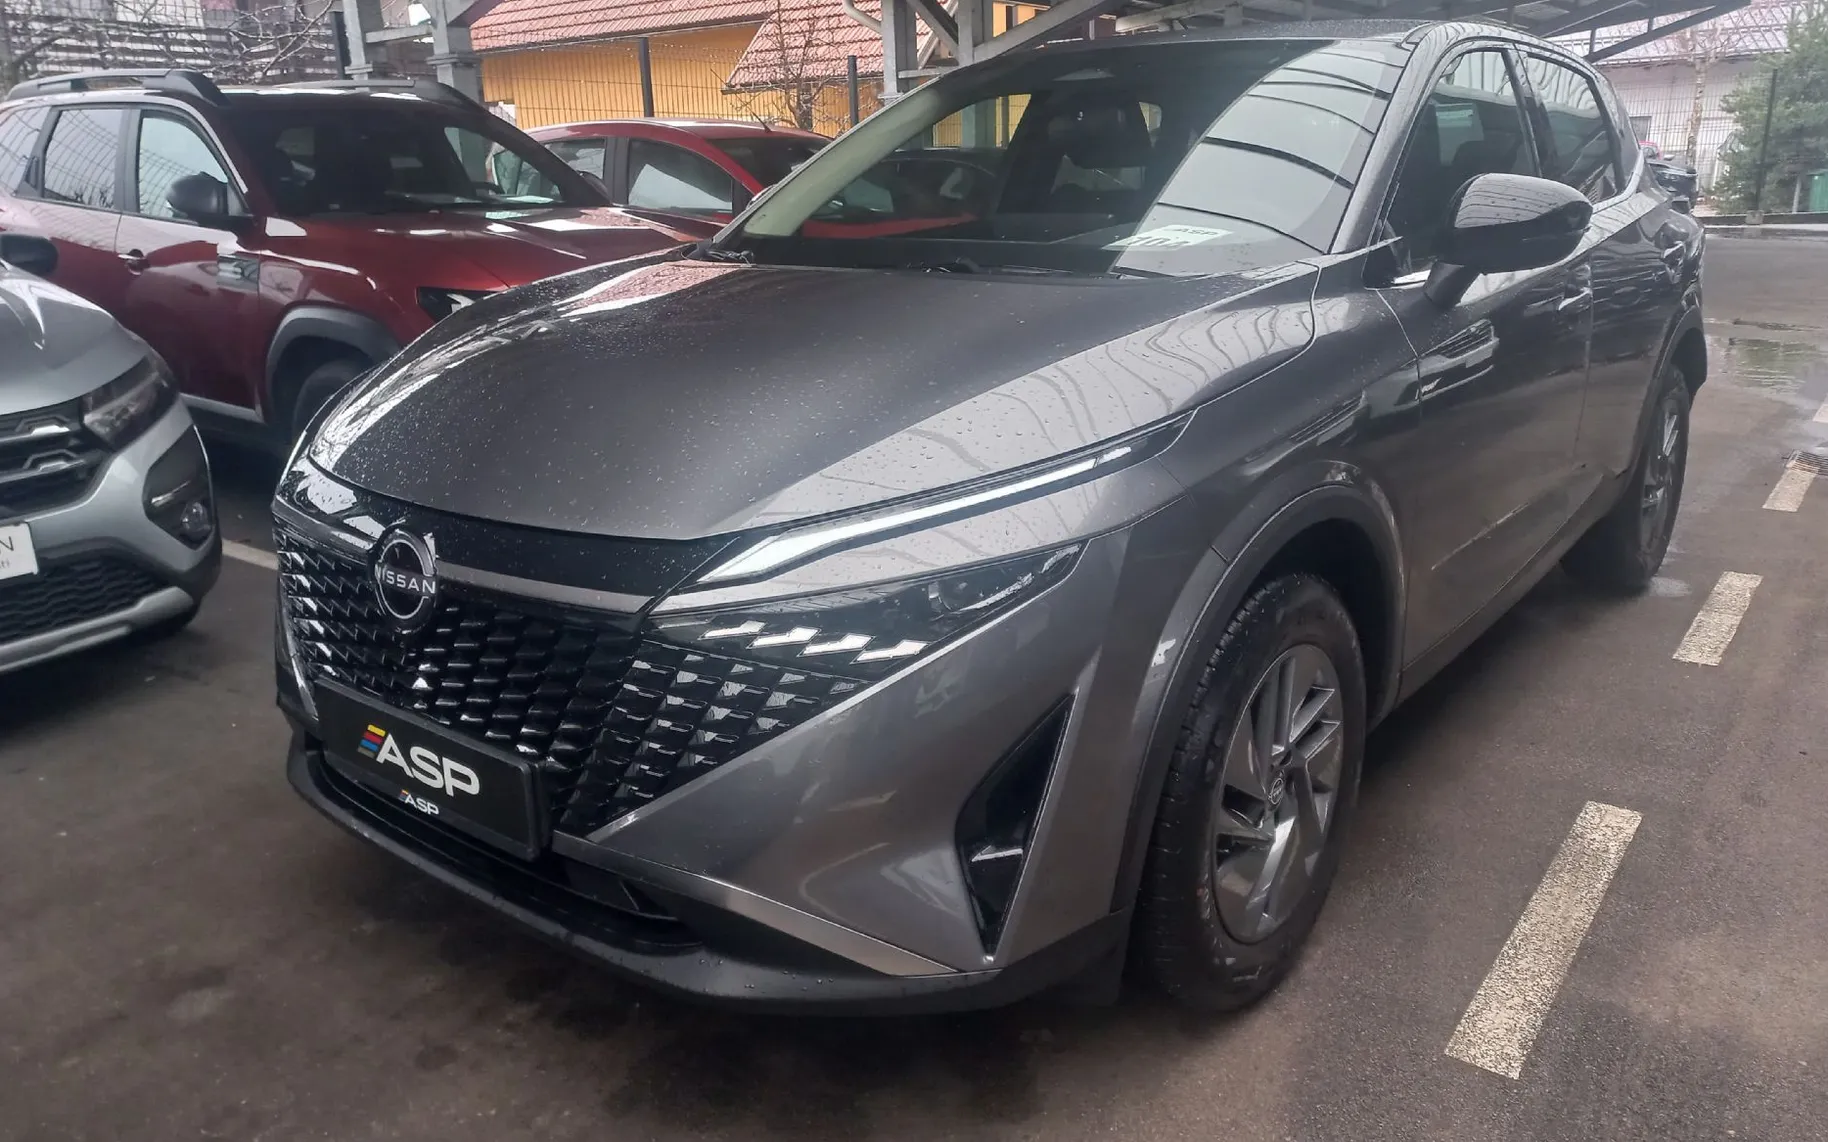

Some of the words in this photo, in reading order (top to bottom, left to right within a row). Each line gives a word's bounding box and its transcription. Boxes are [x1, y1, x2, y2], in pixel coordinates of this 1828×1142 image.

[374, 564, 436, 594] NISSAN
[376, 732, 480, 797] ASP
[405, 793, 440, 815] ASP
